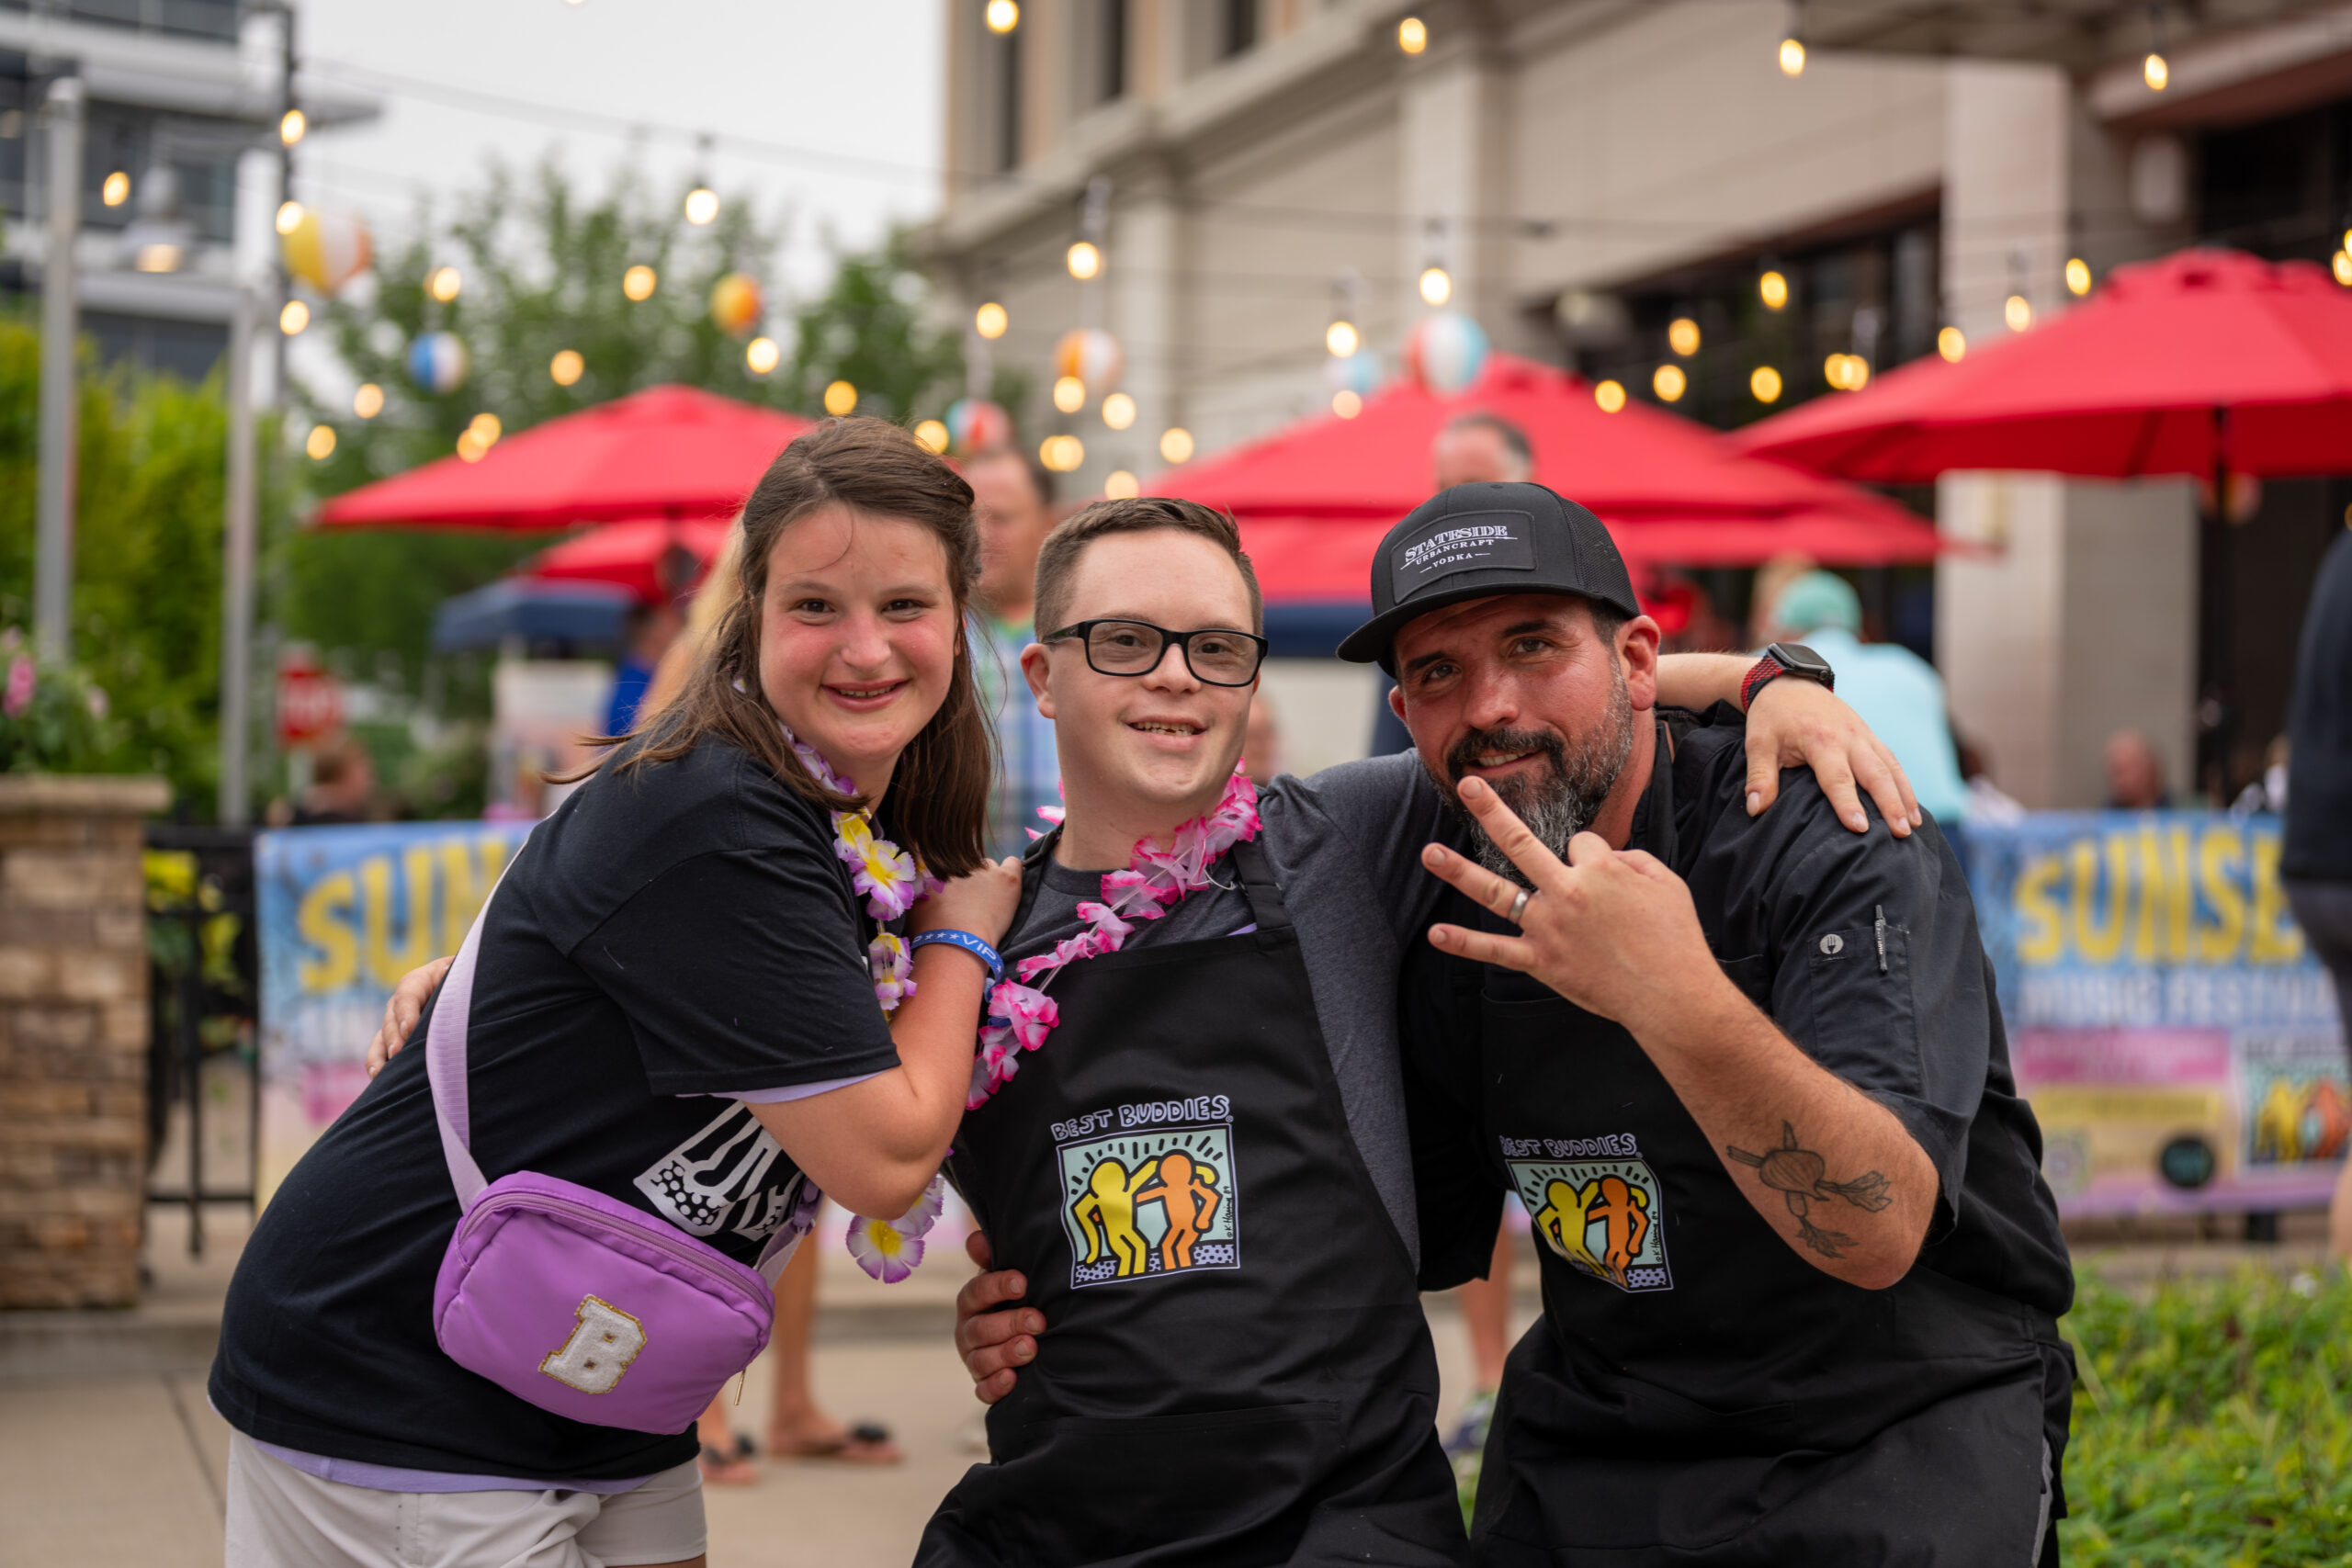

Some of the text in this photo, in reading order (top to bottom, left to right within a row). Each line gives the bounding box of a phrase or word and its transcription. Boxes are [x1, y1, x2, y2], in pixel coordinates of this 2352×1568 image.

[1405, 525, 1508, 562] STATESIDE
[1416, 539, 1494, 565] URBANCRAFT
[1432, 553, 1473, 568] VODKA
[2013, 816, 2304, 964] SUNSE
[299, 840, 509, 994] SUN
[962, 934, 997, 961] VIP
[1051, 1095, 1230, 1141] BEST BUDDIES
[1499, 1133, 1637, 1157] BEST BUDDIES
[538, 1293, 648, 1394] B
